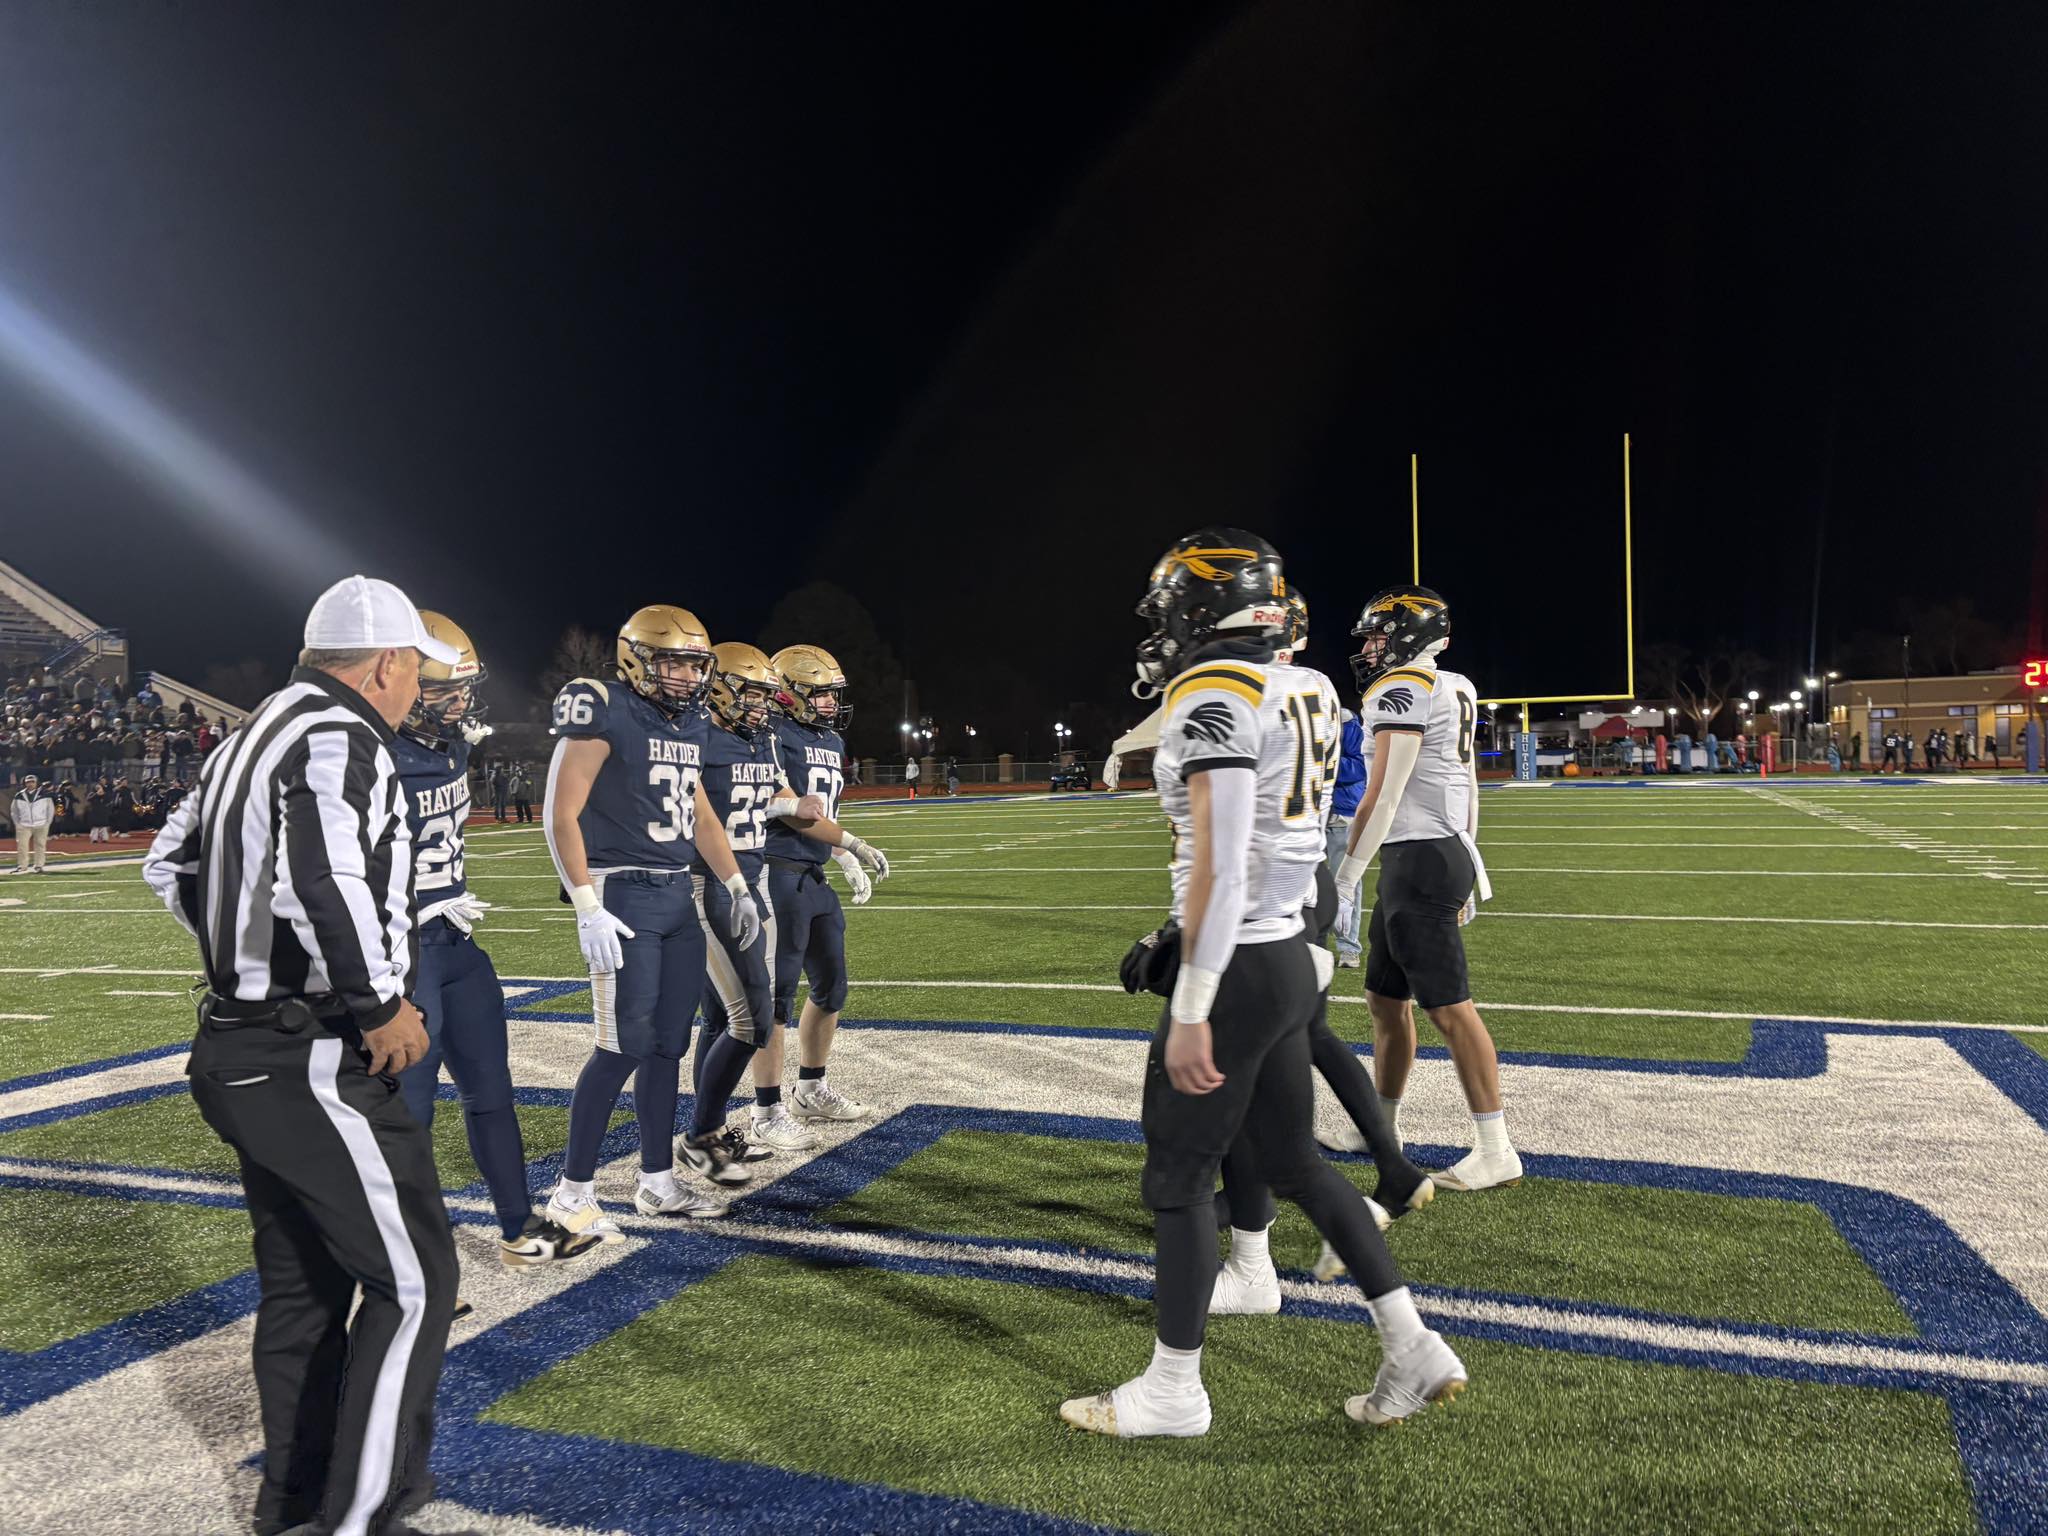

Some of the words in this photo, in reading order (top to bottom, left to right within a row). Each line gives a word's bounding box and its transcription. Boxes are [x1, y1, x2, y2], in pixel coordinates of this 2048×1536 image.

[2025, 662, 2048, 686] 2
[556, 694, 595, 726] 36
[1455, 688, 1474, 766] 8
[648, 738, 700, 766] HAYDEN
[804, 746, 841, 771] HAYDEN
[1282, 691, 1324, 822] 15
[1521, 734, 1530, 780] HUTCH
[731, 763, 775, 783] HAYDEN
[416, 772, 470, 818] HAYDEN
[725, 785, 775, 851] 22
